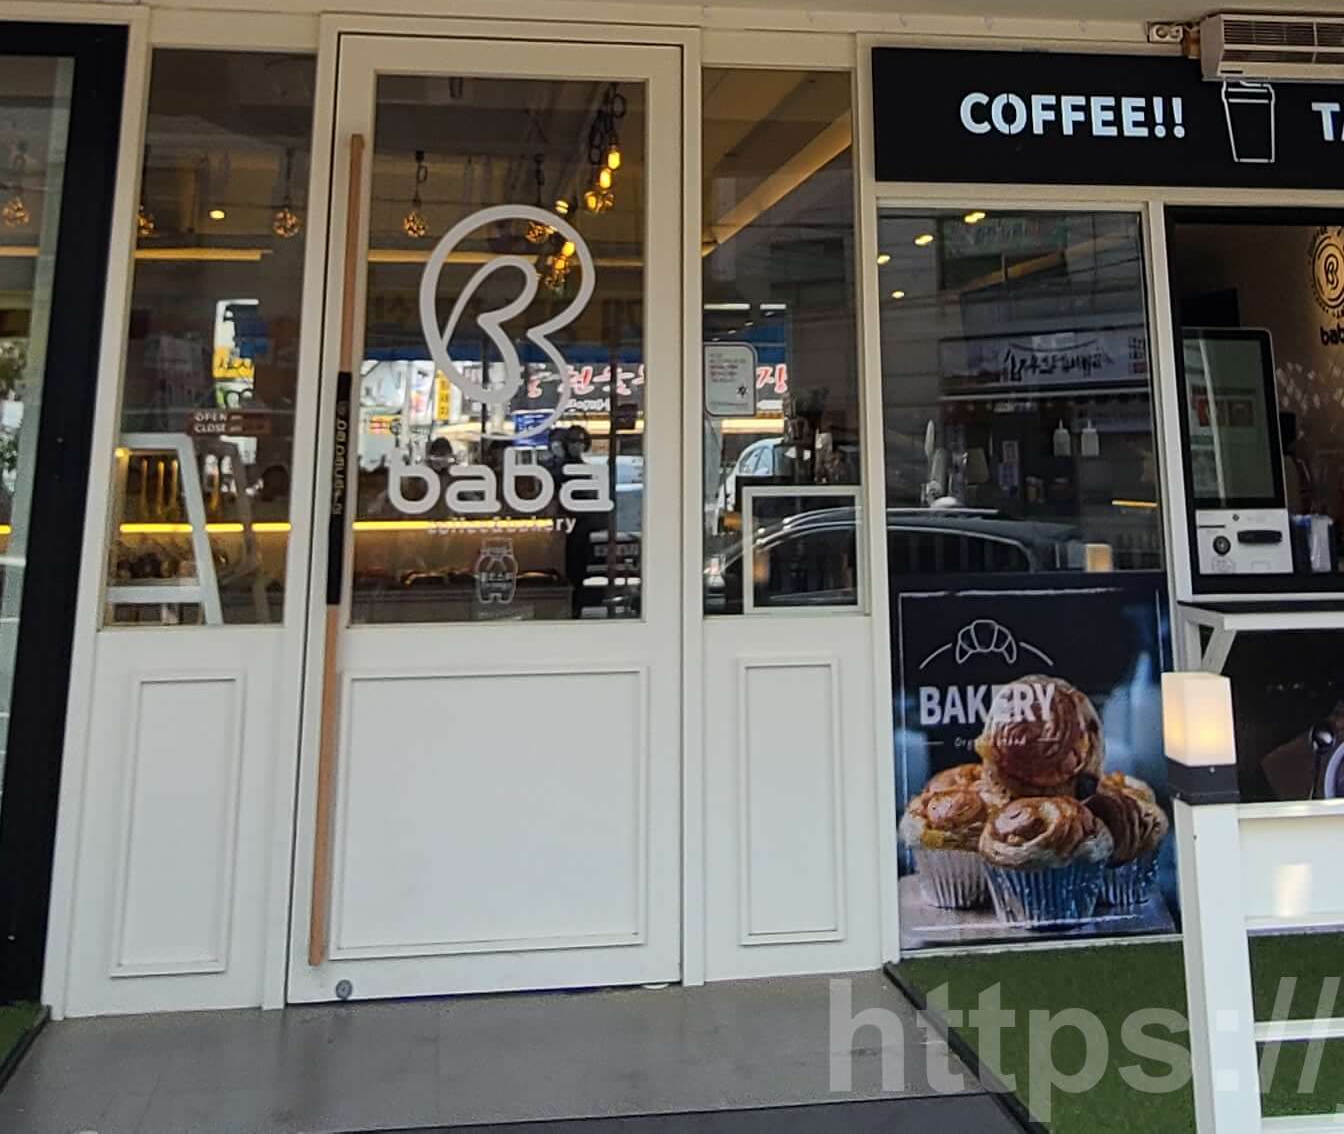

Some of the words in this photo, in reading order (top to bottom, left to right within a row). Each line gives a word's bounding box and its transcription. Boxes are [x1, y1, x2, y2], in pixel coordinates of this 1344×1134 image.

[959, 91, 1187, 141] COFFEE!!
[388, 446, 616, 514] baba
[919, 683, 1056, 726] BAKERY
